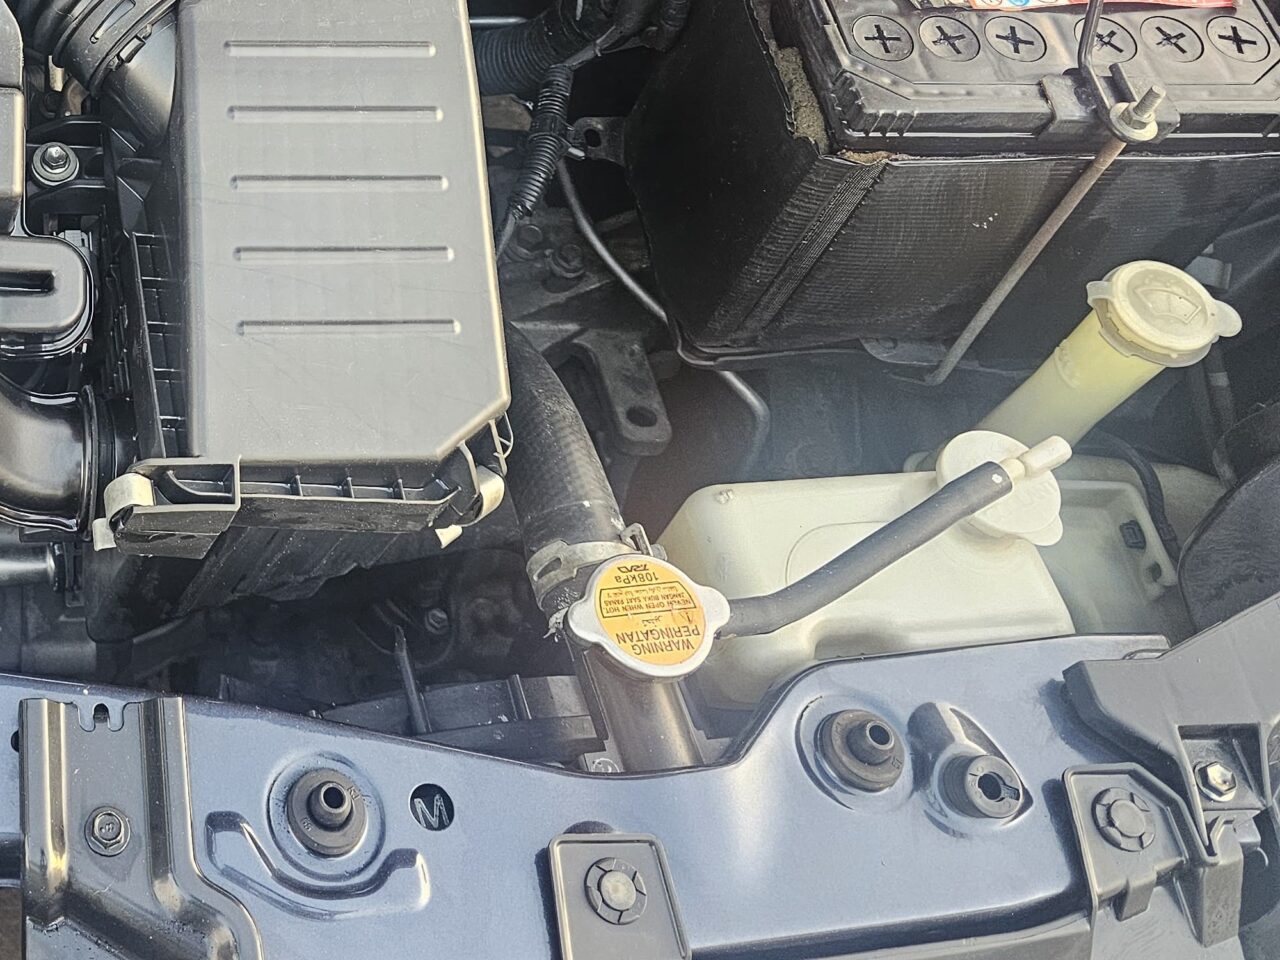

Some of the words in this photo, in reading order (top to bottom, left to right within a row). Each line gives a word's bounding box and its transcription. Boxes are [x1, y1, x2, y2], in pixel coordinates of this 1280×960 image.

[614, 571, 659, 584] 108kPa
[625, 596, 641, 604] SAAT
[642, 594, 660, 602] BUKA
[661, 591, 685, 601] JANGAN
[604, 598, 625, 606] PANAS
[645, 601, 665, 609] OPEN
[622, 603, 643, 612] WHEN
[615, 624, 700, 644] PERINGATAN
[631, 638, 695, 656] WARNING
